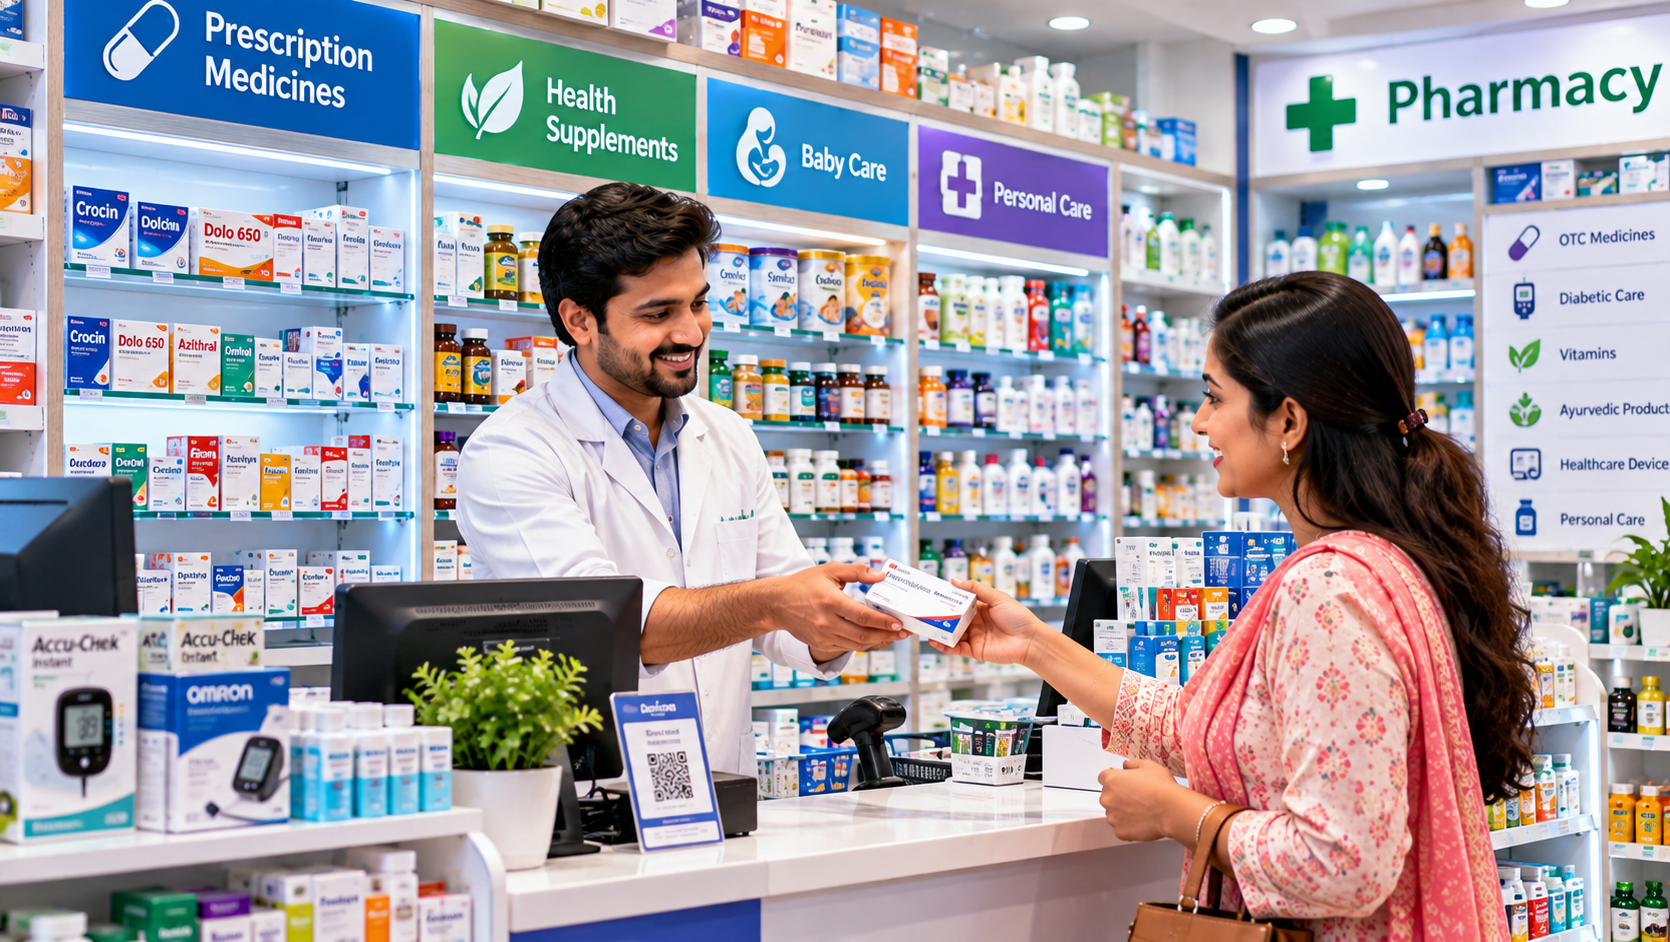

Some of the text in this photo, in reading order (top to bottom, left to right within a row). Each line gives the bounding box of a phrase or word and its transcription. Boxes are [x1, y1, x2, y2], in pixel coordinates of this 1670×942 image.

[205, 11, 373, 72] Prescription
[205, 55, 346, 109] Medicines
[547, 77, 617, 115] Health
[1388, 63, 1663, 125] Pharmacy
[546, 115, 679, 163] Supplements
[801, 143, 887, 182] Baby Care
[994, 181, 1092, 220] Personal Care
[76, 201, 119, 220] Crocin
[204, 222, 261, 243] Dolo 650
[1559, 229, 1656, 247] OTC Medicines
[1559, 289, 1645, 305] Diabetic Care
[70, 329, 106, 344] Crocin
[118, 334, 164, 349] Dolo 650
[178, 338, 217, 352] Azithral
[1559, 347, 1617, 361] Vitamins
[1559, 403, 1620, 419] Ayurvedic
[1560, 457, 1625, 471] Healthcare
[1560, 512, 1645, 526] Personal Care
[32, 655, 73, 669] Instant
